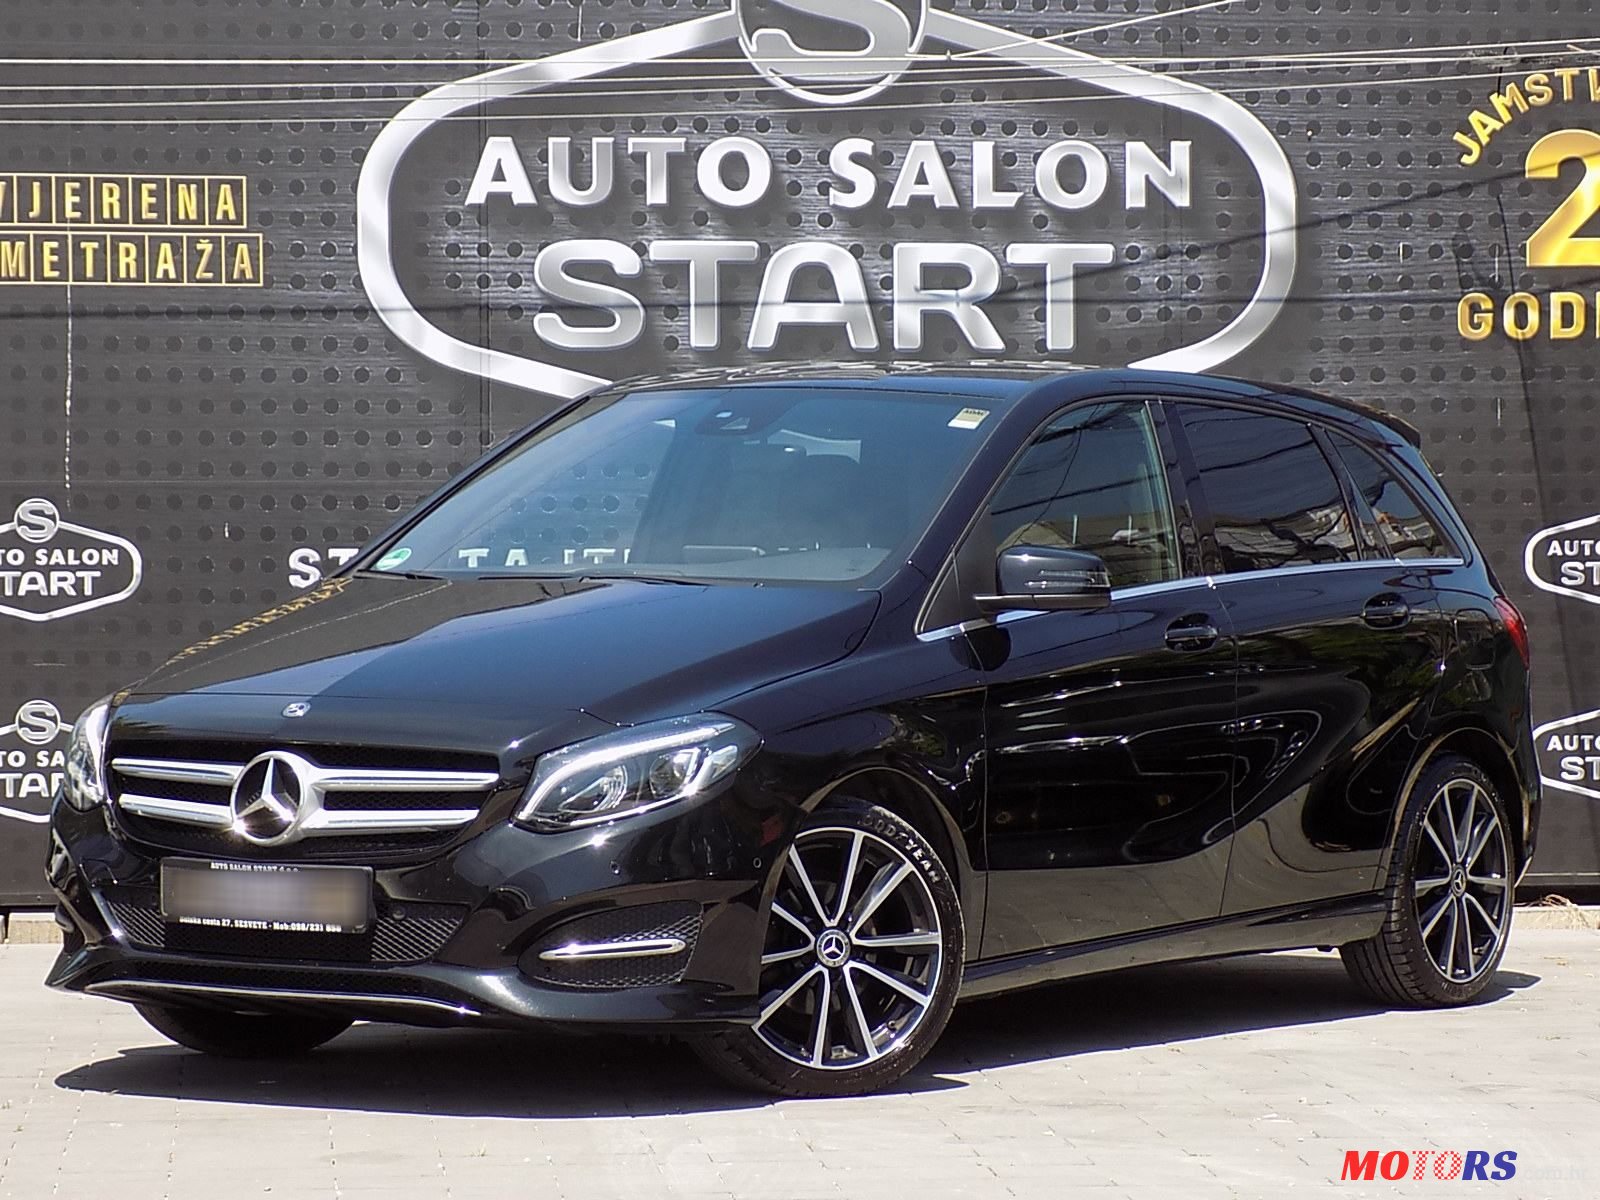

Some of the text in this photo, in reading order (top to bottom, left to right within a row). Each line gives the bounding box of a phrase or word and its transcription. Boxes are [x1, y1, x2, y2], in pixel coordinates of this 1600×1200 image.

[465, 136, 1192, 210] AUTO SALON
[533, 239, 1116, 352] START
[35, 548, 119, 566] SALON
